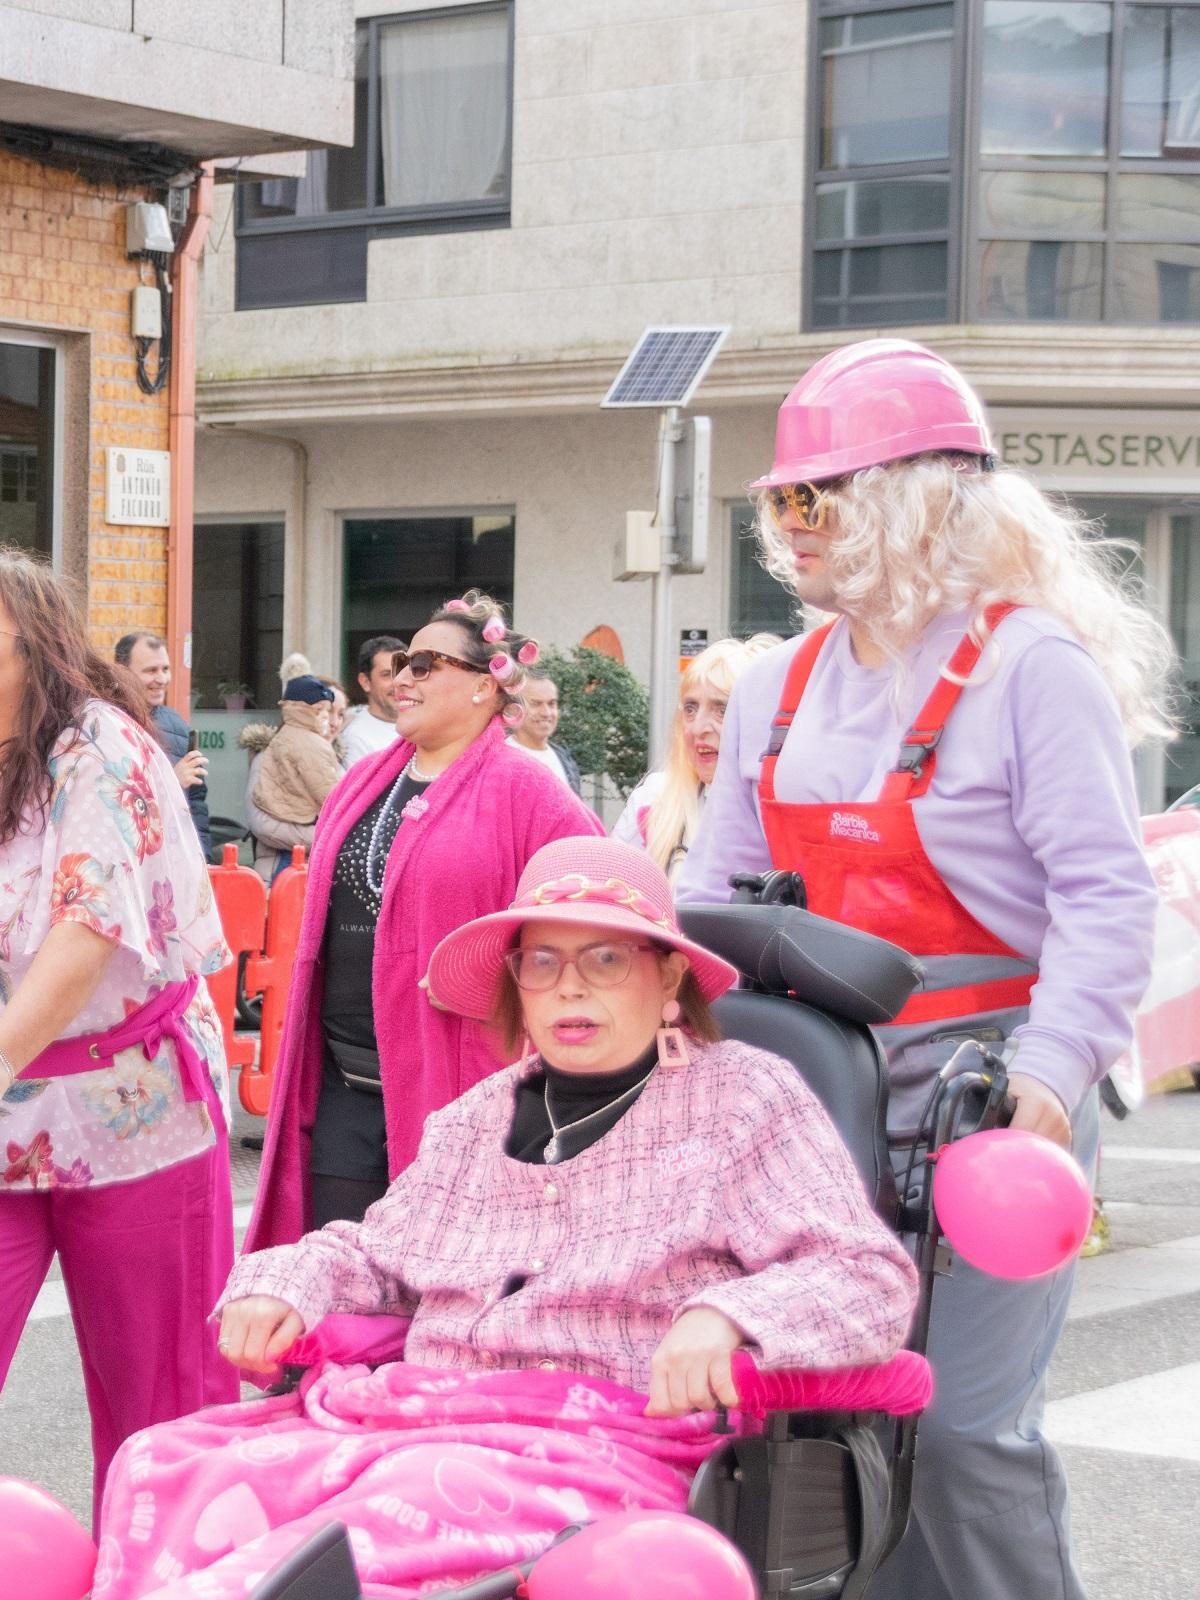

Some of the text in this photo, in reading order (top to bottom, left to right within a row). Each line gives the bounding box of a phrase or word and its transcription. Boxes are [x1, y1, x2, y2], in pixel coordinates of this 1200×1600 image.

[1000, 432, 1200, 467] ESTASERVI
[122, 476, 161, 497] ANTONIO
[831, 811, 869, 830] Barbie
[657, 1140, 703, 1164] Barbie
[128, 1490, 156, 1542] GOOD
[436, 1519, 480, 1546] THE
